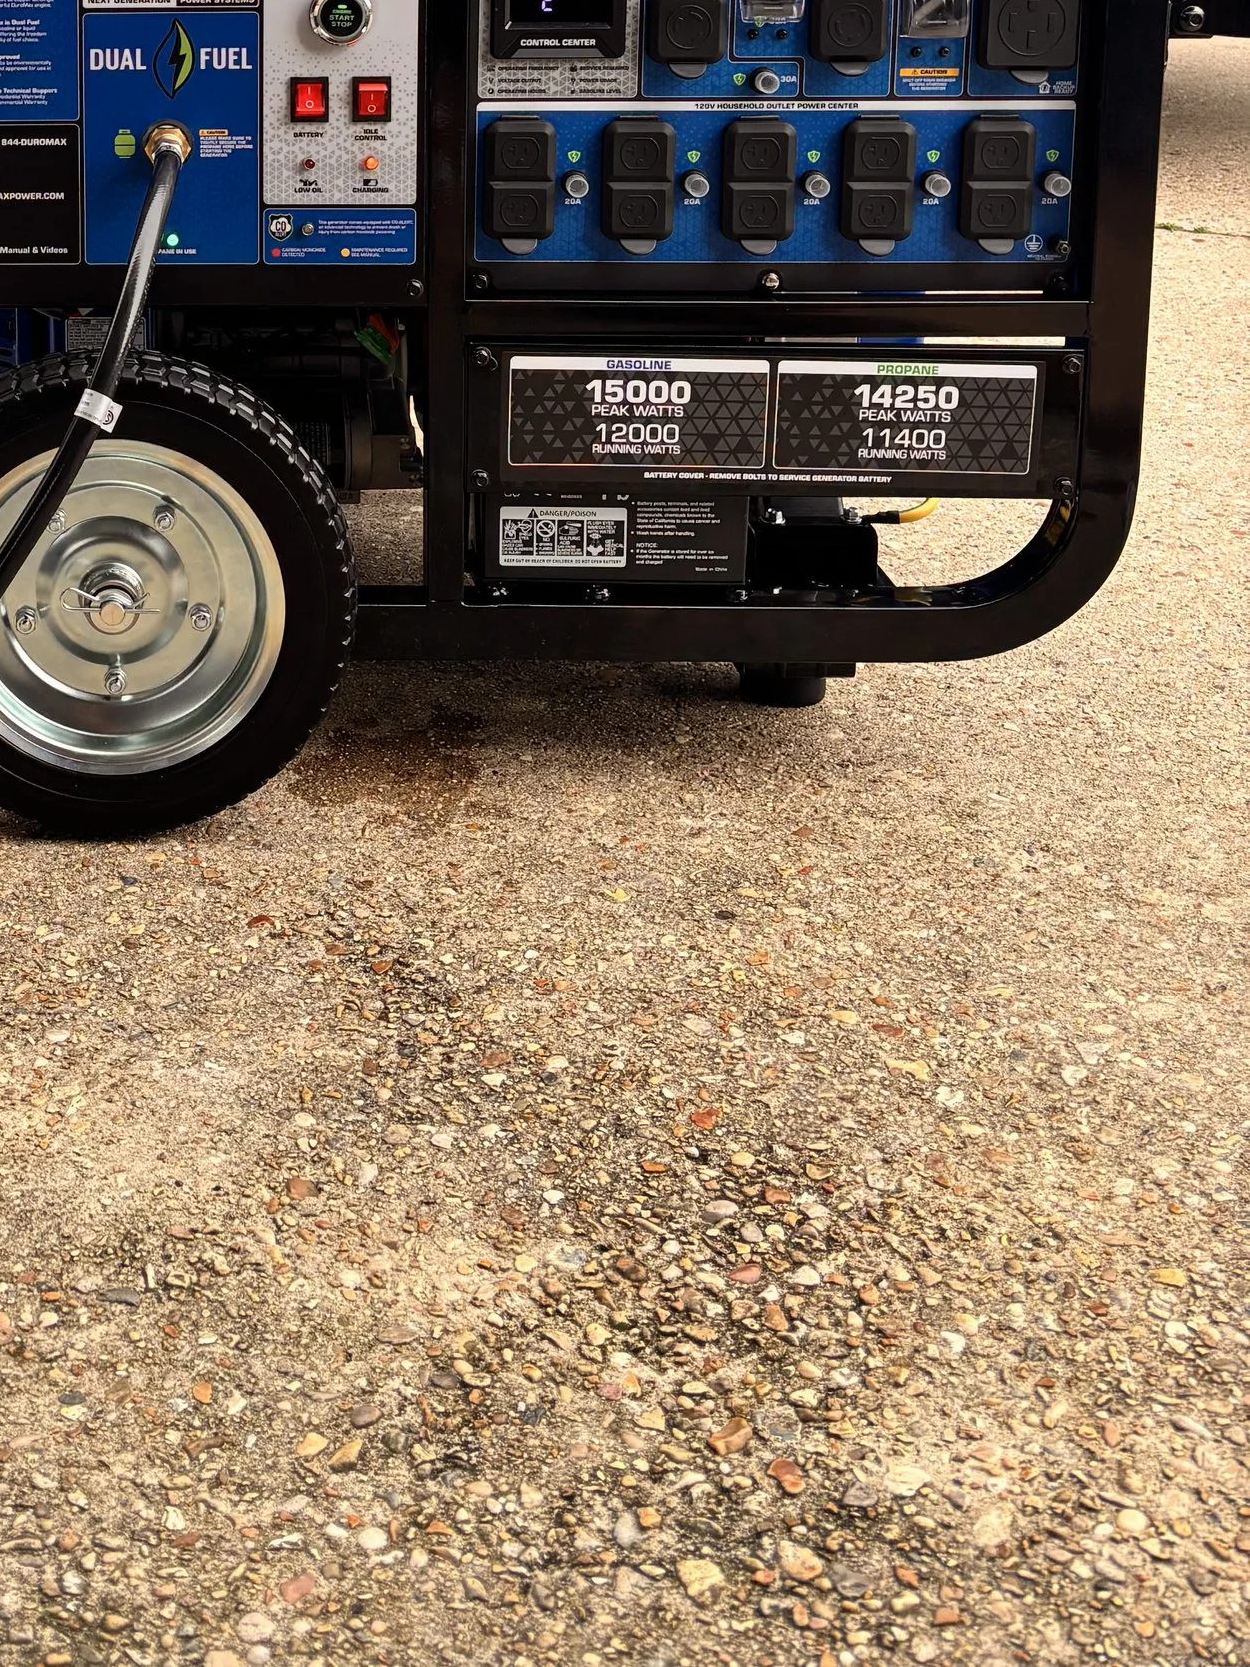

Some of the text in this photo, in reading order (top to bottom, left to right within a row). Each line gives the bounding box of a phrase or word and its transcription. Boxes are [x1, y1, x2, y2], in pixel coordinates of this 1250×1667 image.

[89, 47, 253, 70] DUAL FUEL
[780, 75, 797, 83] 30A
[1, 138, 67, 146] 844-DUROMAX
[1041, 197, 1058, 205] 20A
[275, 220, 287, 232] CO
[0, 246, 30, 254] Manual
[32, 246, 39, 254] &
[40, 246, 68, 254] Videos
[606, 359, 672, 370] GASOLINE
[876, 364, 939, 375] PROPANE
[585, 379, 692, 405] 15000
[853, 384, 960, 410] 14250
[591, 405, 684, 417] PEAK WATTS
[858, 409, 952, 423] PEAK WATTS
[595, 423, 680, 444] 12000
[862, 428, 946, 449] 11400
[592, 444, 681, 455] RUNNING WATTS
[857, 448, 946, 461] RUNNING WATTS
[644, 471, 678, 479] BATTERY
[679, 472, 705, 480] COVER
[709, 472, 742, 480] REMOVE
[742, 472, 766, 480] BOLTS
[767, 473, 778, 481] TO
[779, 474, 811, 482] SERVICE
[811, 474, 857, 483] GENERATOR
[858, 475, 893, 484] BATTERY
